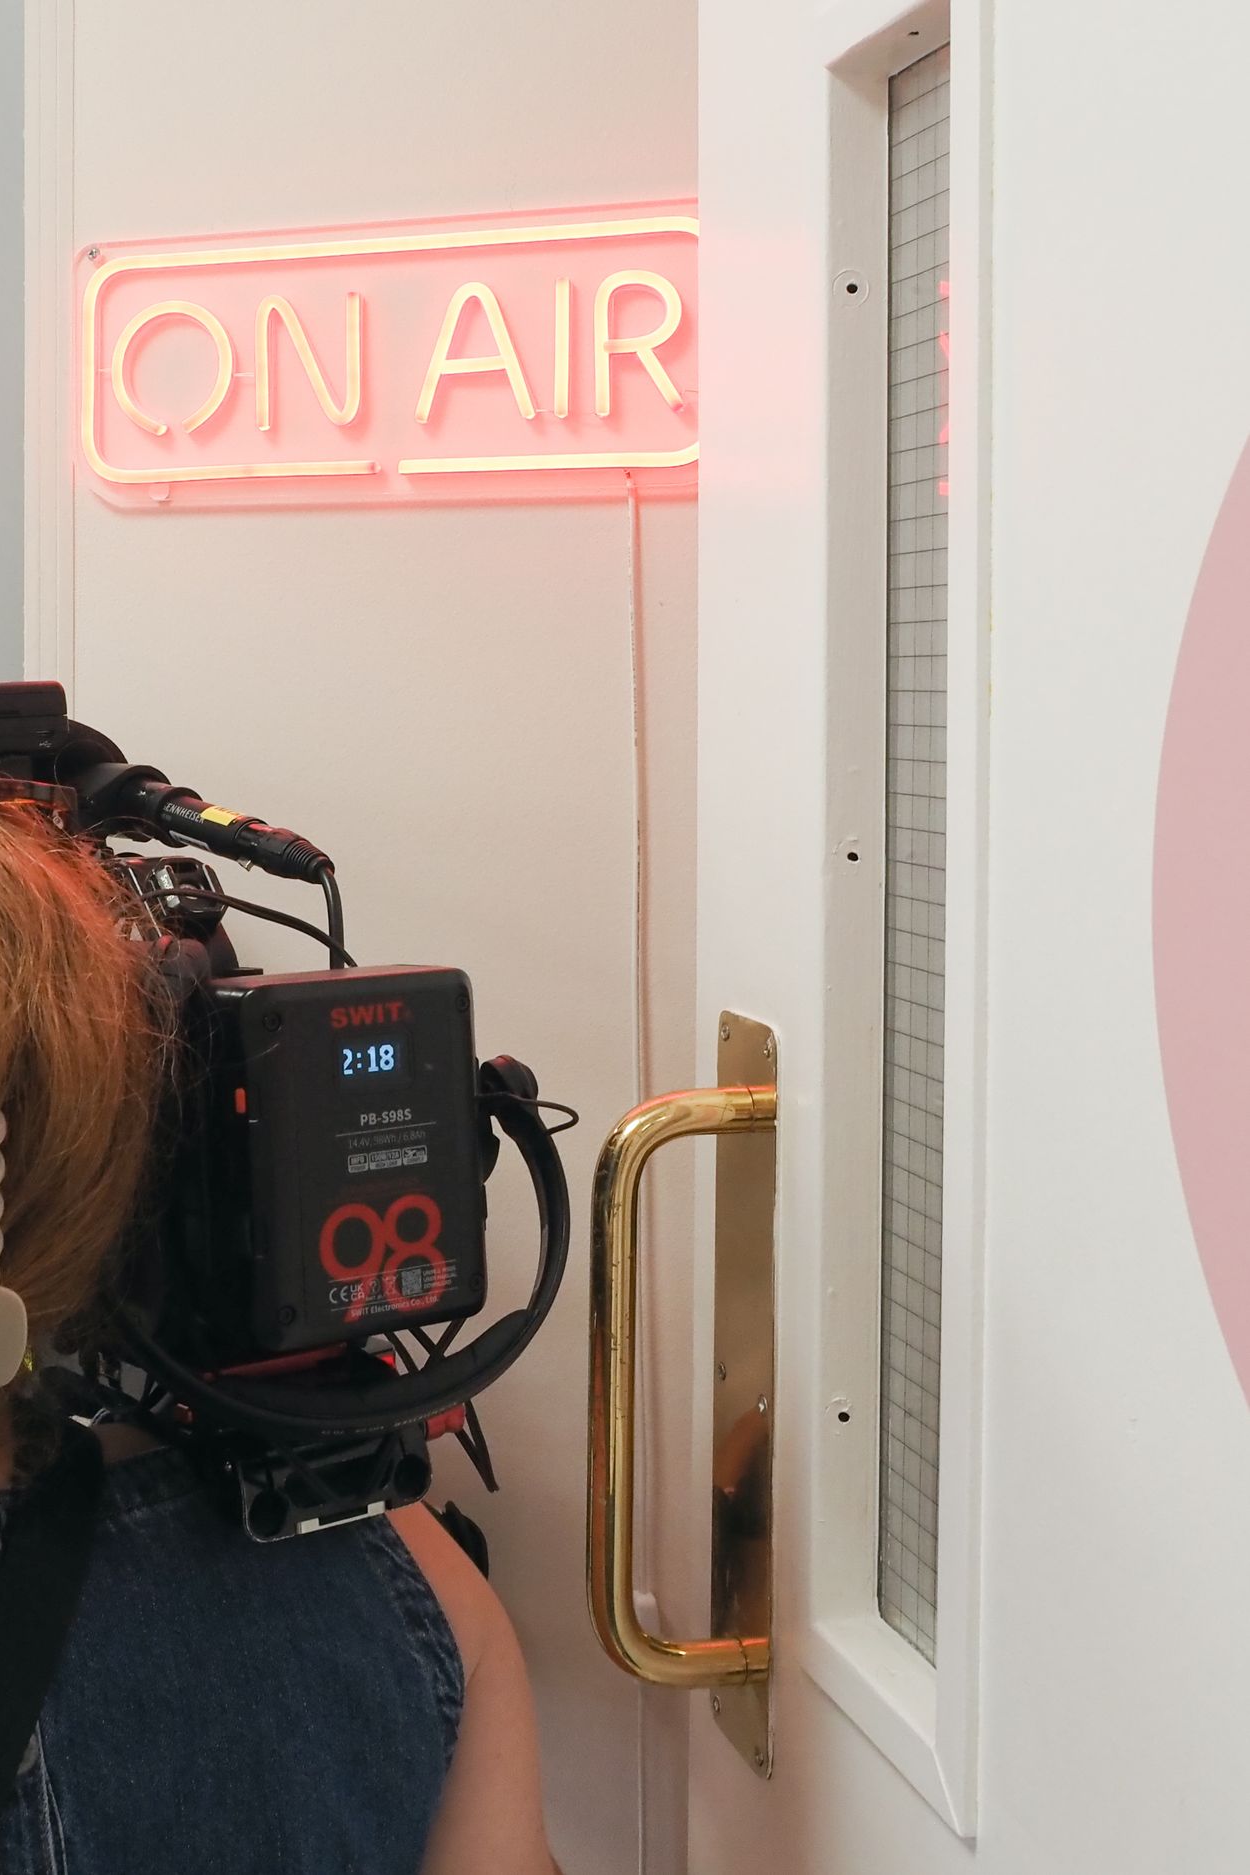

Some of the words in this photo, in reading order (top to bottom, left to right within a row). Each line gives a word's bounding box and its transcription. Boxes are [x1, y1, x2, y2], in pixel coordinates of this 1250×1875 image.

[111, 291, 361, 435] ON
[414, 269, 683, 424] AIR
[331, 1001, 404, 1029] SWIT
[342, 1043, 395, 1075] 2:18
[360, 1108, 412, 1126] PB-S98S
[319, 1192, 447, 1323] 98
[350, 1305, 369, 1318] SWIT
[370, 1300, 409, 1314] Electronics
